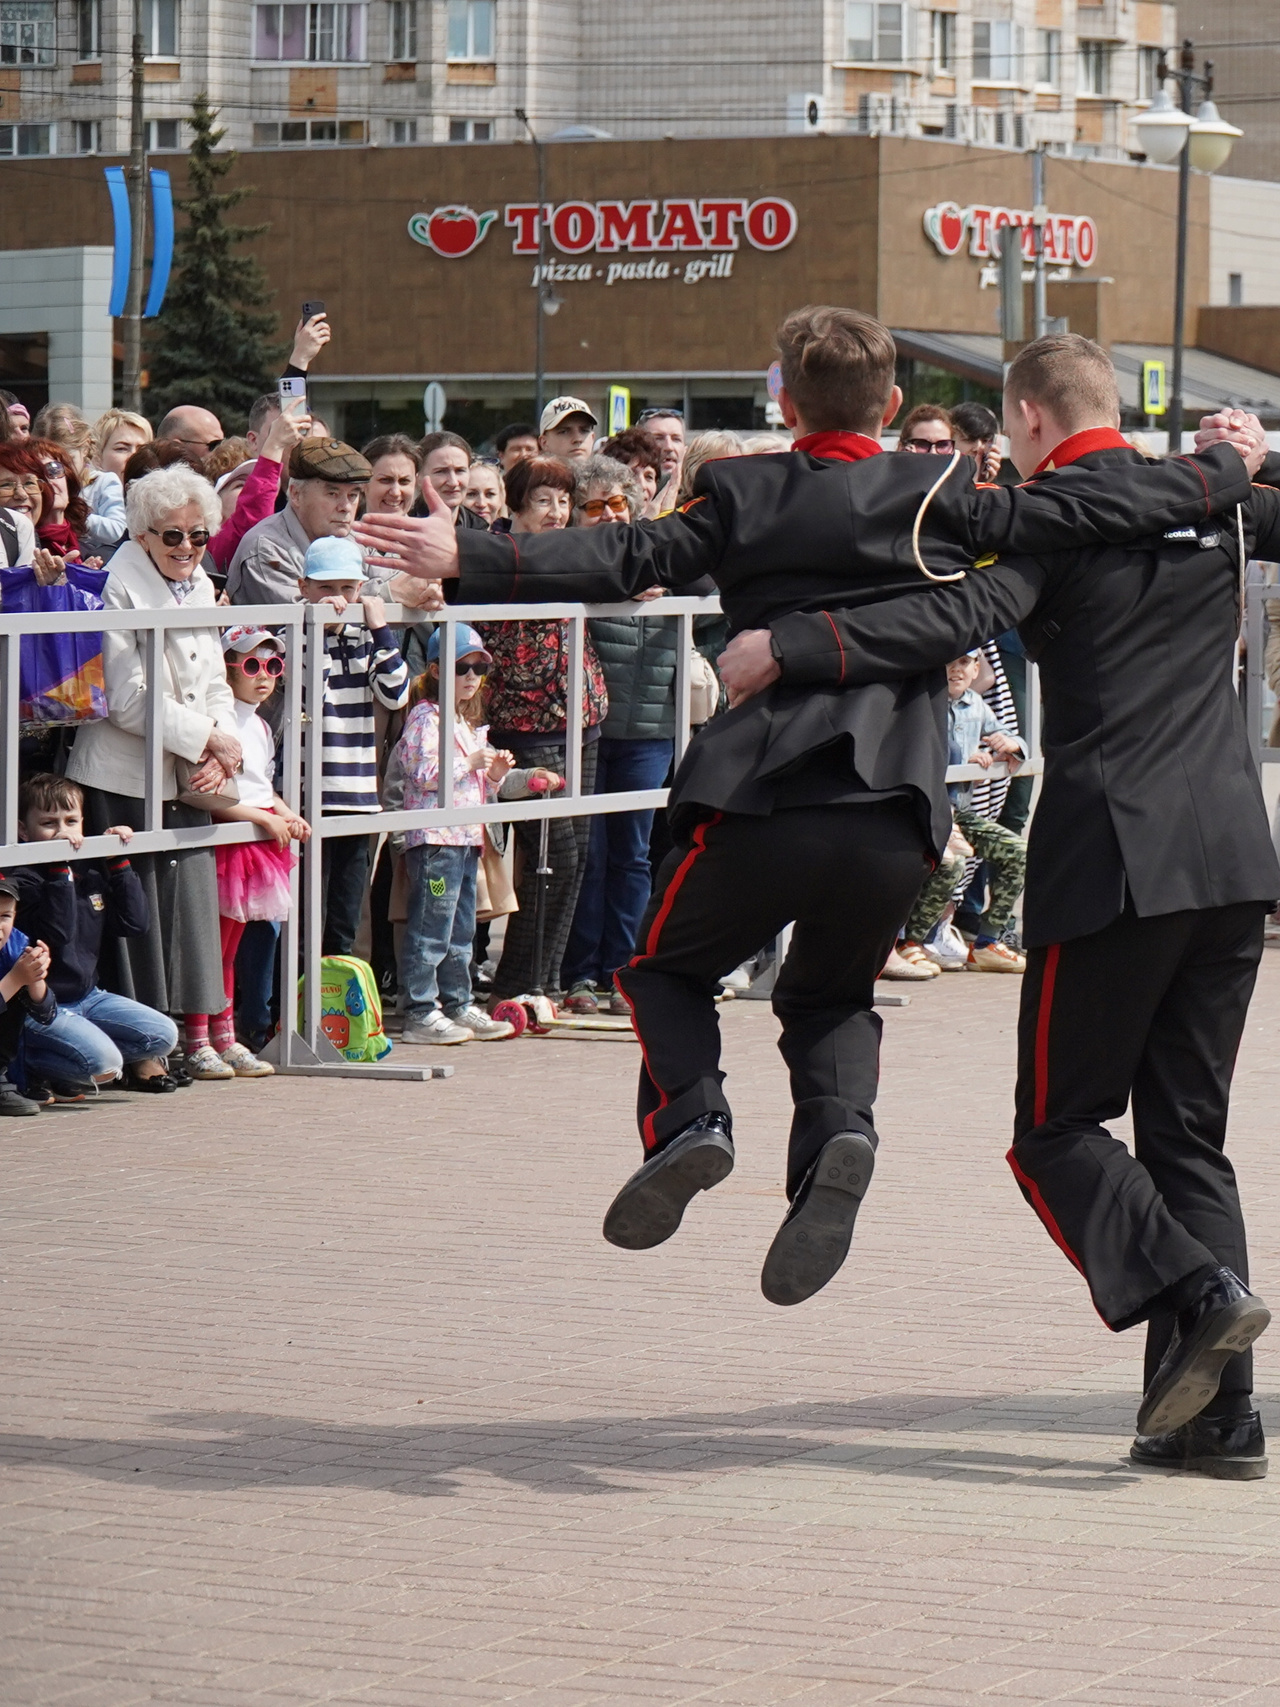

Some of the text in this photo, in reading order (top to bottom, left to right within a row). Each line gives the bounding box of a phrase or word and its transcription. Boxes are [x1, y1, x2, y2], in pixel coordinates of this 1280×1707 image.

[505, 197, 798, 254] TOMATO
[530, 252, 734, 287] pizza pasta grill
